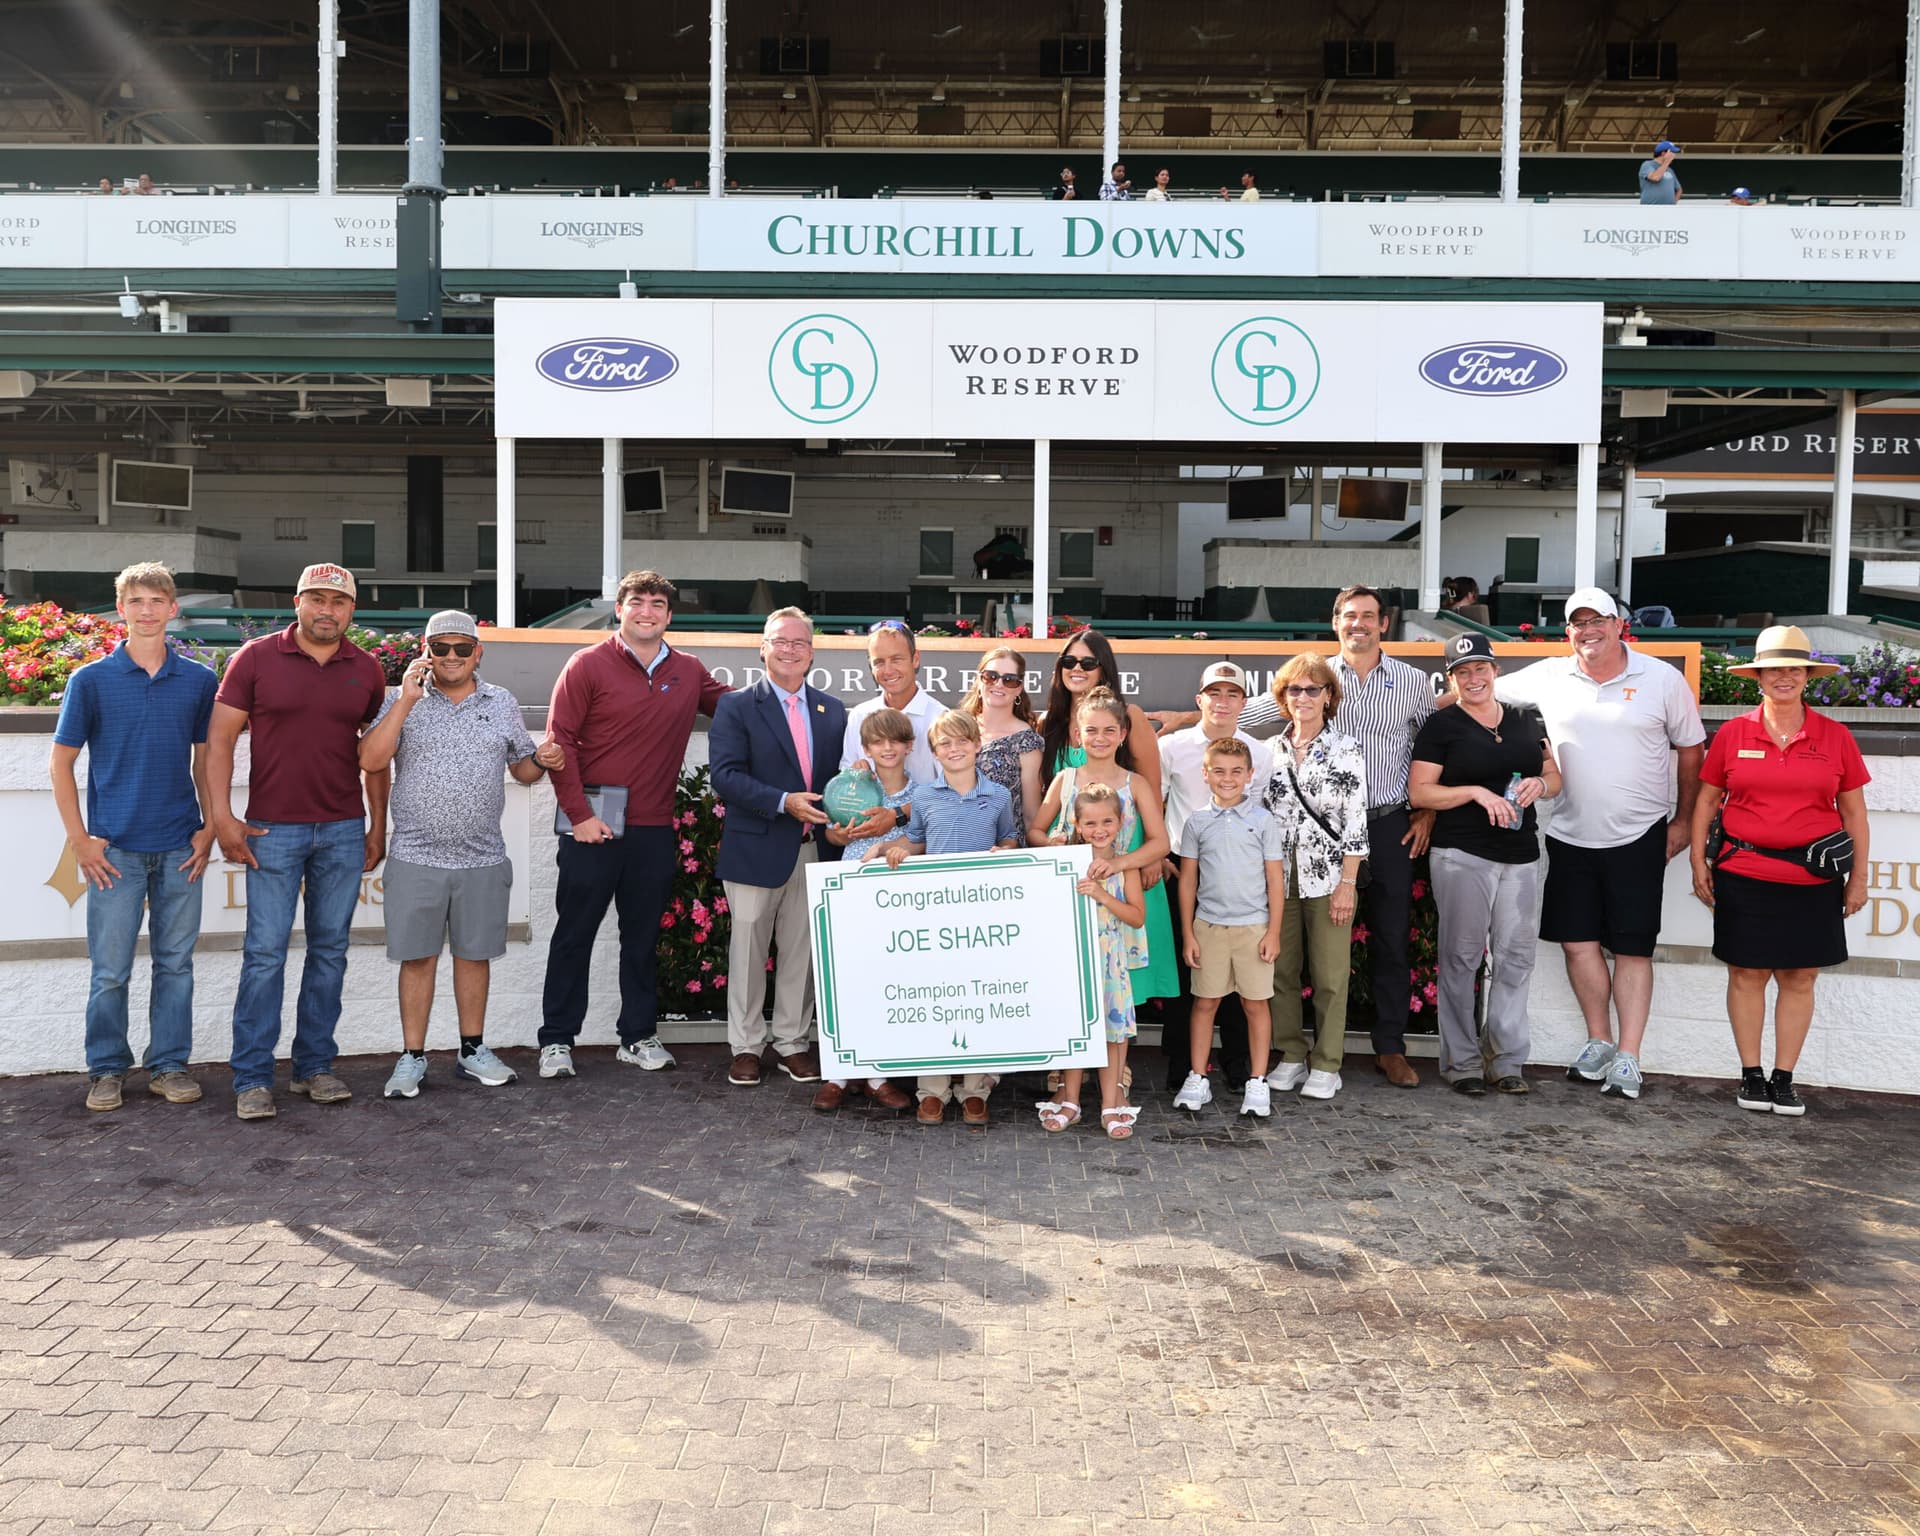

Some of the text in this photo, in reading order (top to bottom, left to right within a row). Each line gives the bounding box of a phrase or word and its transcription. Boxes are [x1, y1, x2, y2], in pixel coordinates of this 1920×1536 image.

[0, 217, 40, 229] ORD
[136, 219, 237, 235] LONGINES
[541, 222, 644, 237] LONGINES
[1368, 224, 1484, 237] WOODFORD
[345, 235, 396, 248] RESE
[767, 214, 1245, 260] CHURCHILL DOWNS
[1583, 229, 1689, 245] LONGINES
[1790, 227, 1906, 241] WOODFORD
[1380, 243, 1474, 256] RESERVE
[1802, 247, 1896, 260] RESERVE
[948, 344, 1139, 365] WOODFORD
[564, 345, 650, 381] Ford
[1448, 350, 1538, 386] Ford
[965, 375, 1120, 396] RESERVE
[1456, 638, 1474, 654] CD
[1622, 687, 1638, 701] T
[875, 883, 1025, 911] Congratulations
[886, 923, 1021, 953] JOE SHARP
[884, 979, 1029, 1002] Champion Trainer
[887, 1001, 1032, 1025] 2026 Spring Meet
